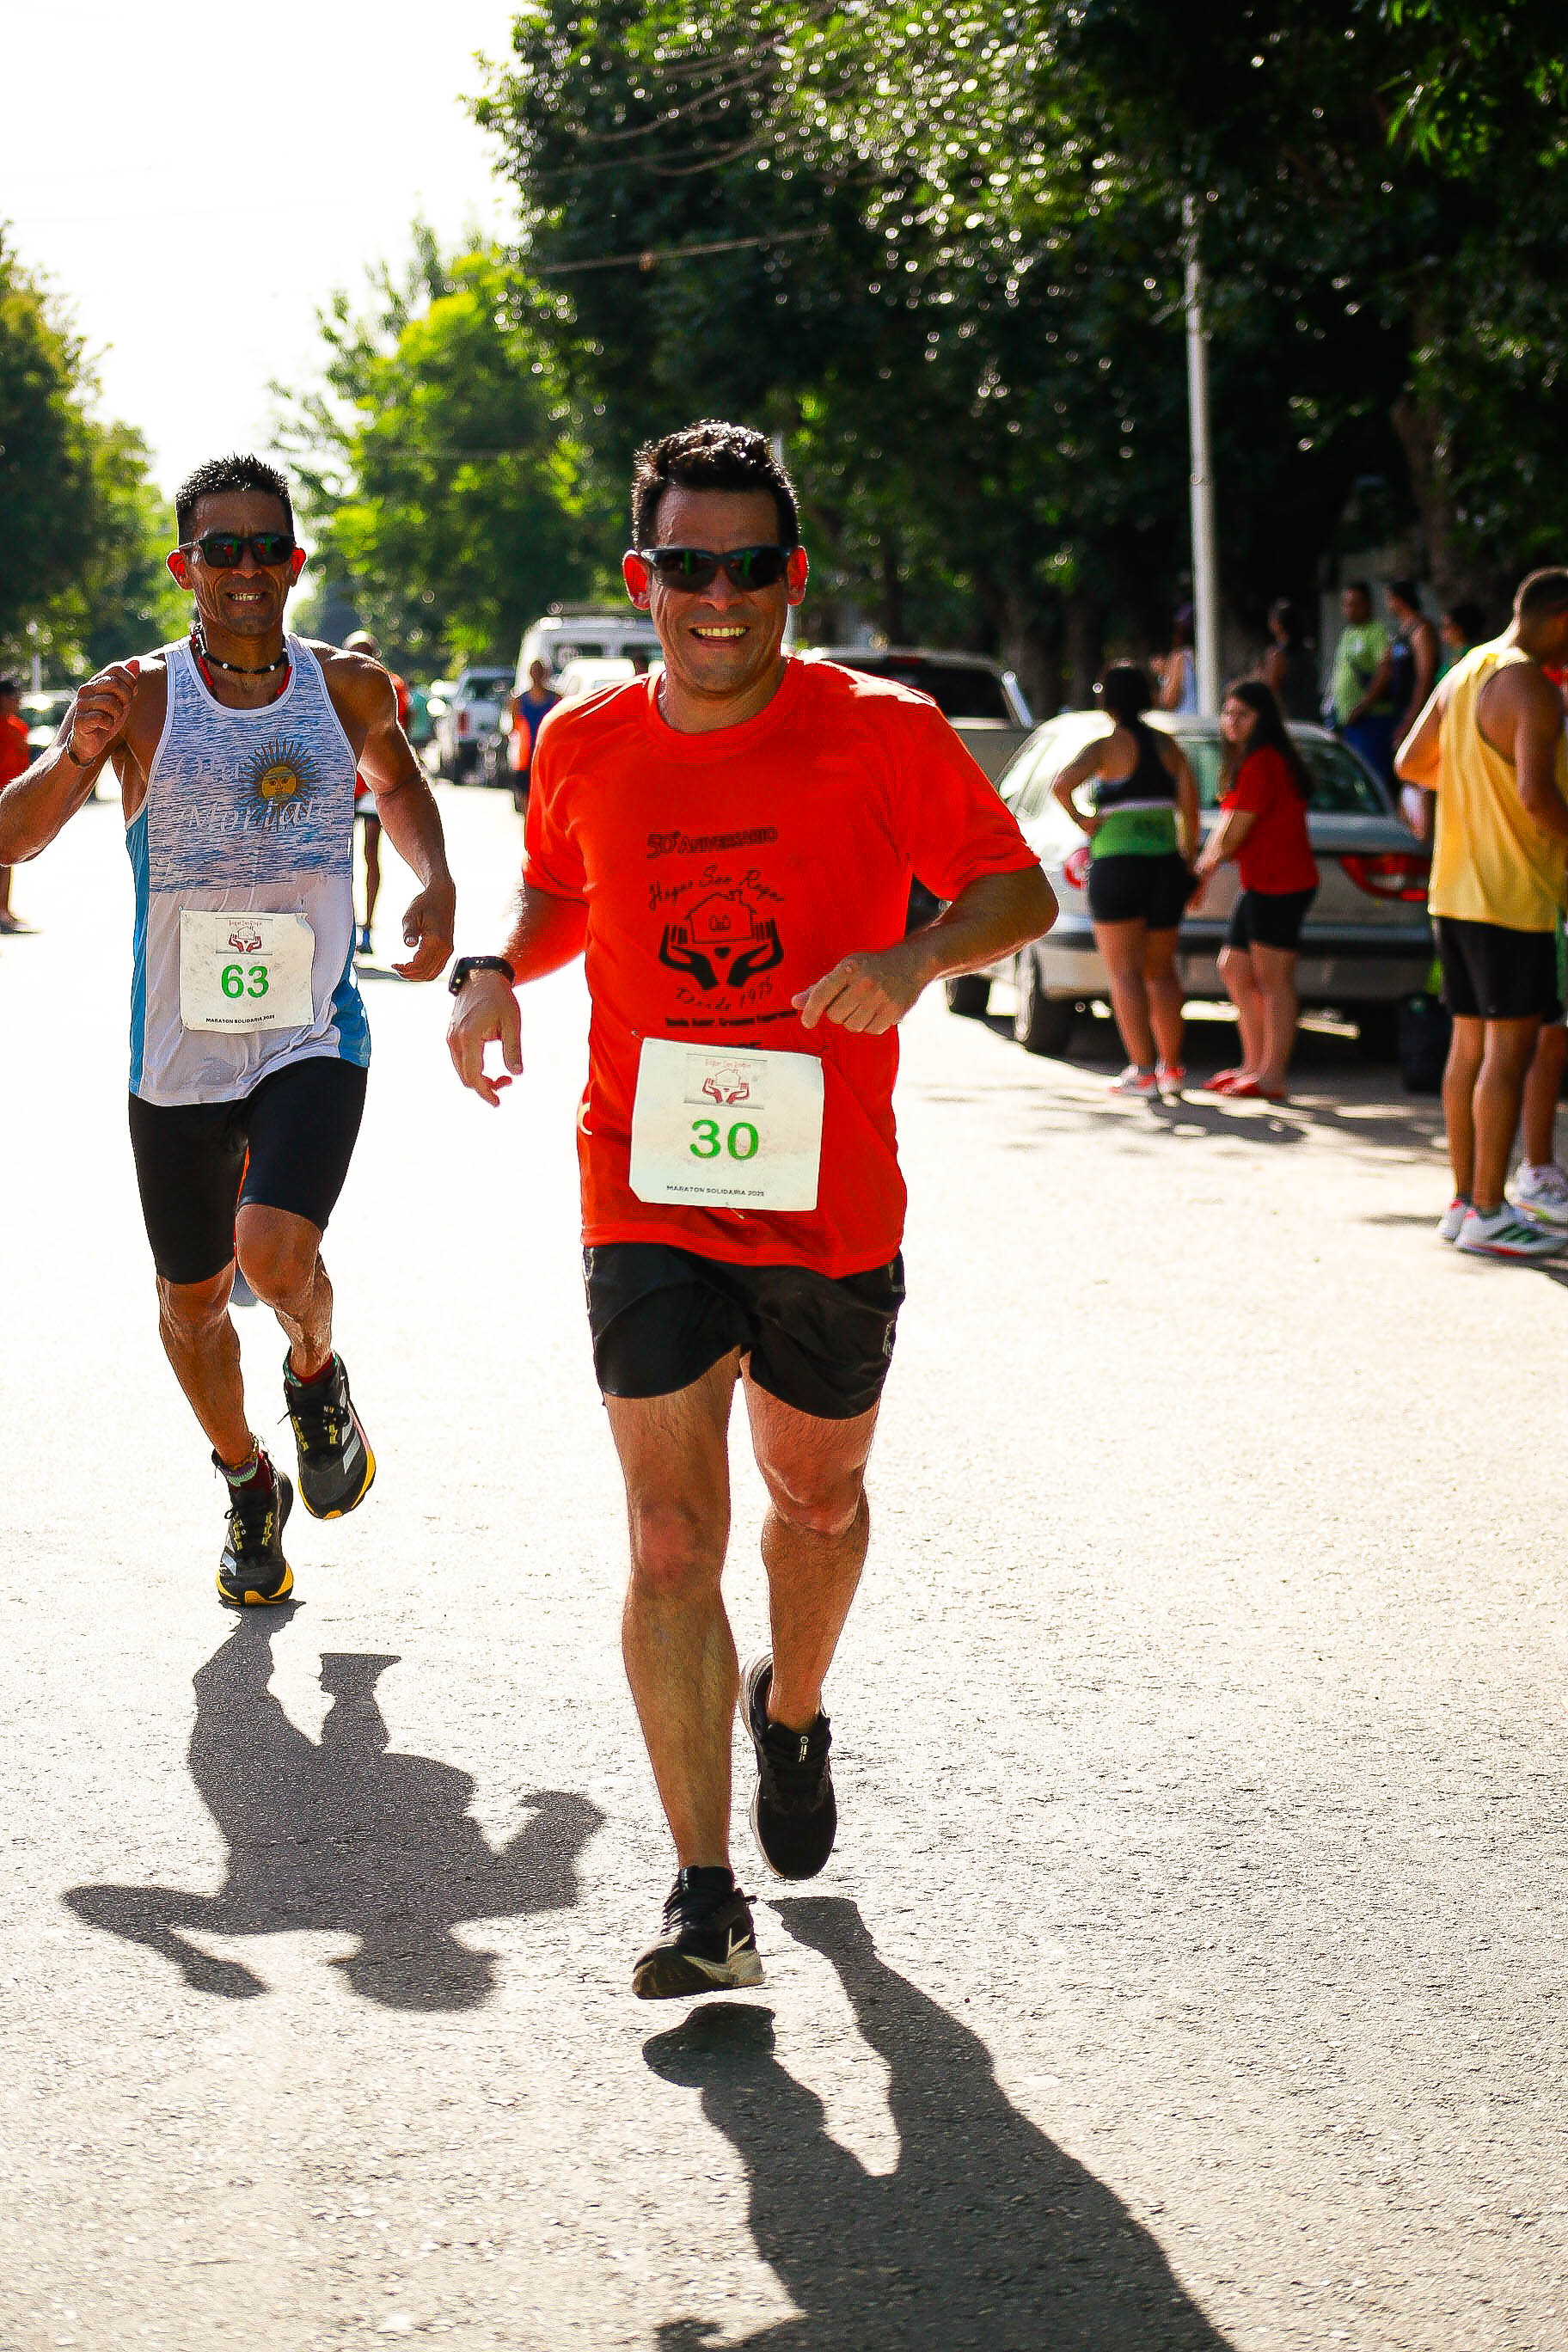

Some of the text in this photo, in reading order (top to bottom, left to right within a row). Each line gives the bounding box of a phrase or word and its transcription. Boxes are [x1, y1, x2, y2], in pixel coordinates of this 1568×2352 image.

[221, 964, 270, 999] 63
[689, 1118, 759, 1161] 30
[666, 1185, 705, 1193] MARATON
[707, 1187, 746, 1196] SOLIDARIA
